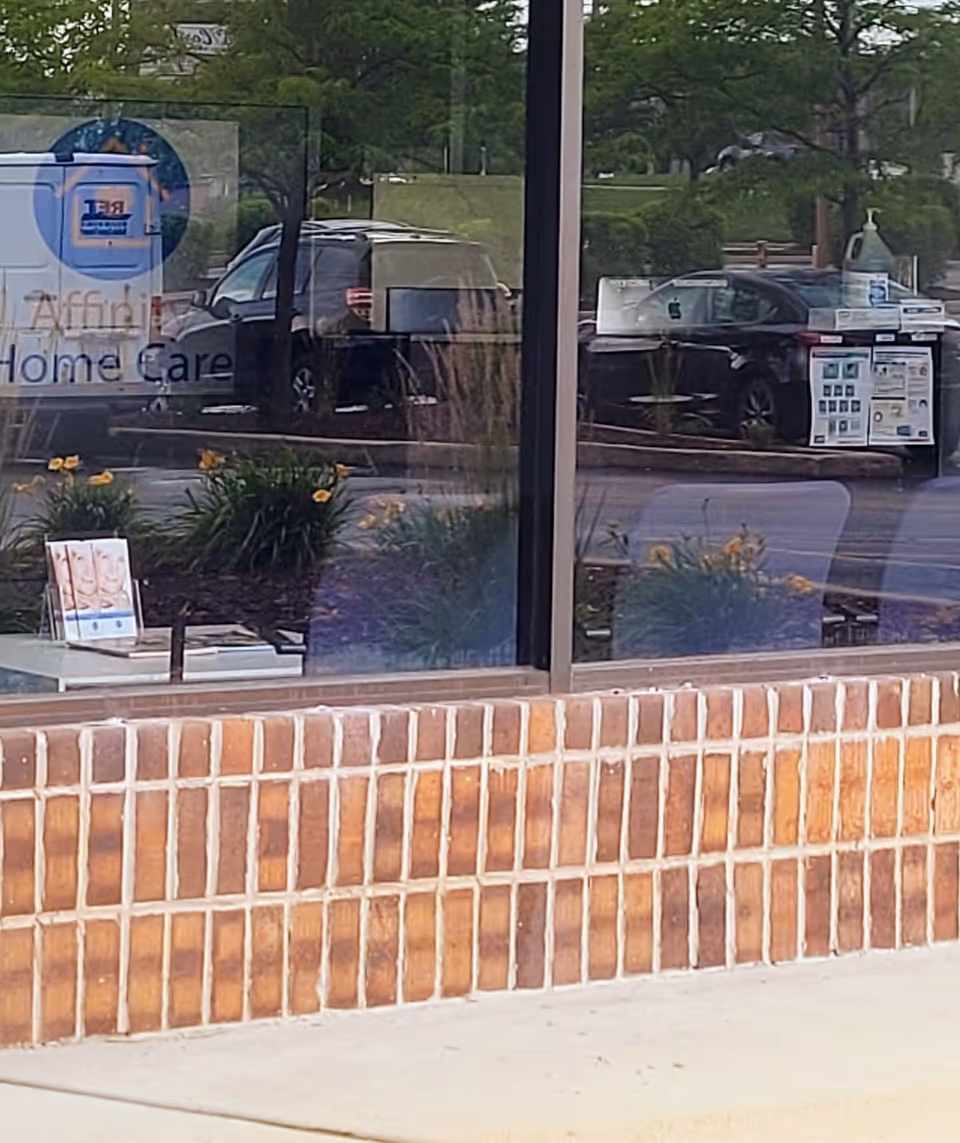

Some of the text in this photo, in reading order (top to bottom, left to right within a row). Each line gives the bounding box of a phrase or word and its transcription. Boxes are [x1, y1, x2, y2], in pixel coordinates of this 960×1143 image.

[31, 289, 180, 332] Affini
[0, 343, 233, 383] Home Care
